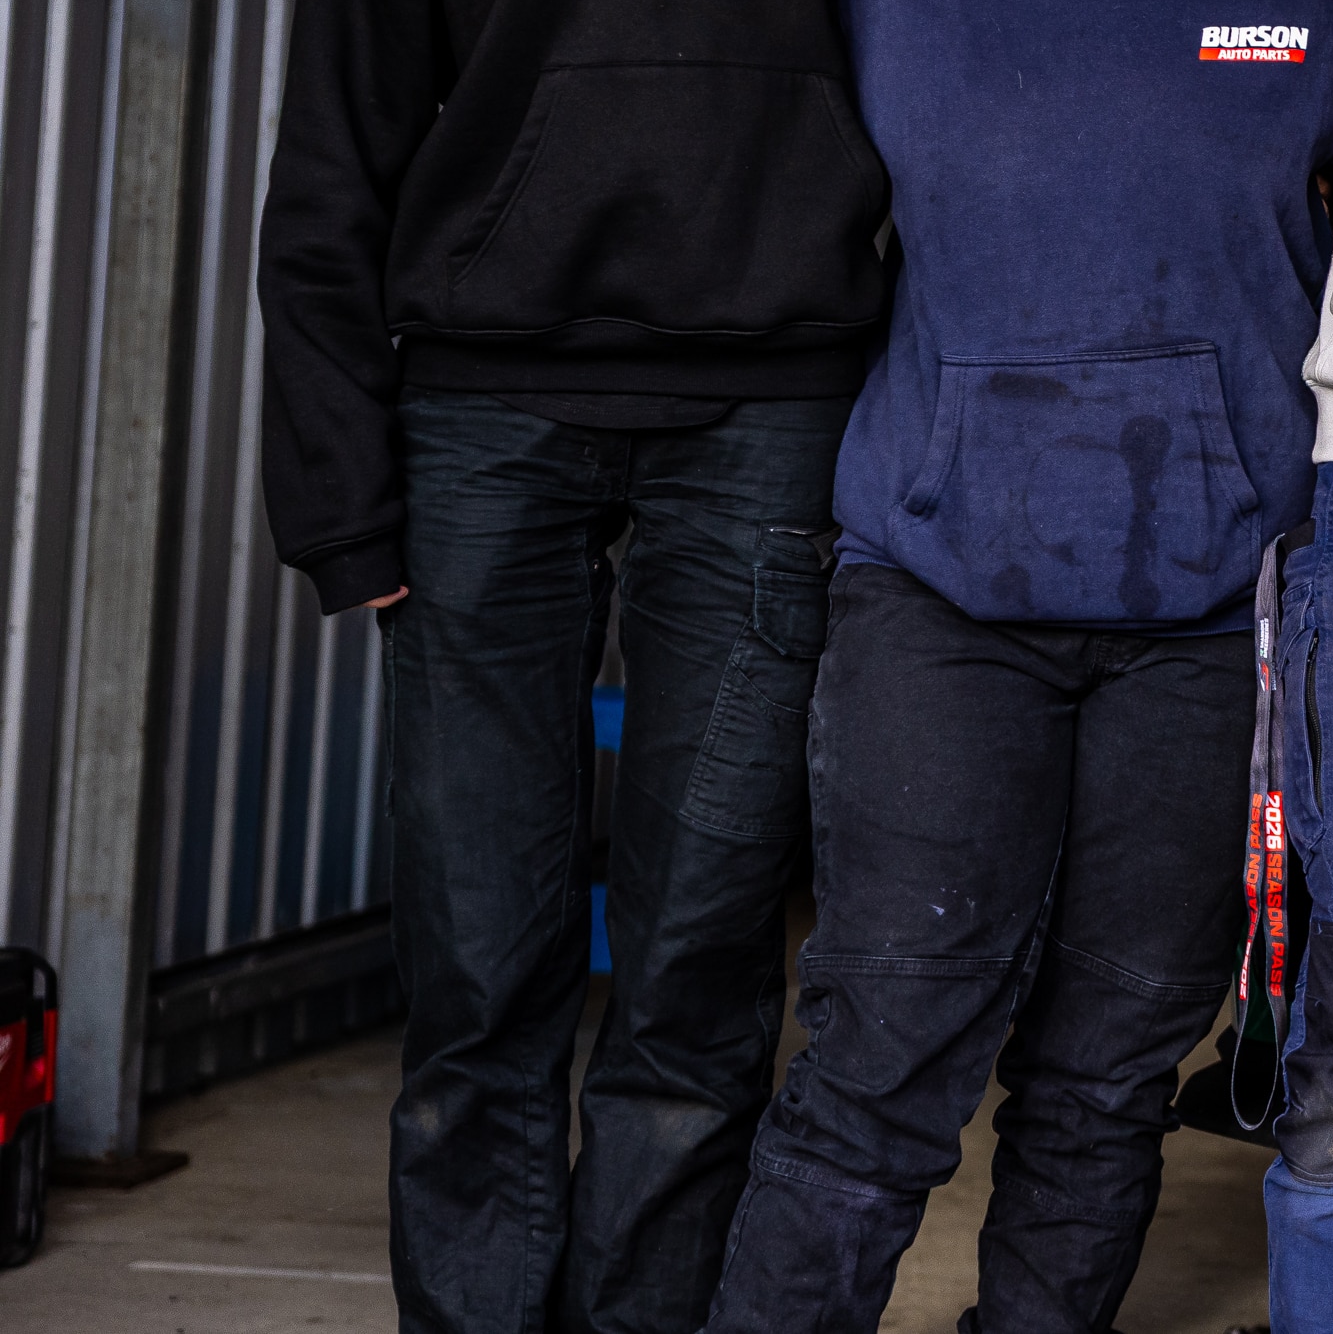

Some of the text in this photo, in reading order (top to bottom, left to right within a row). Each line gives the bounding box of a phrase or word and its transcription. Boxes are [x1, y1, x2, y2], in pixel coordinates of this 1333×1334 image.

[1201, 26, 1309, 50] BURSON
[1218, 49, 1291, 61] AUTO PARTS
[1250, 793, 1263, 849] PASS
[1265, 793, 1285, 997] 2026 SEASON PASS
